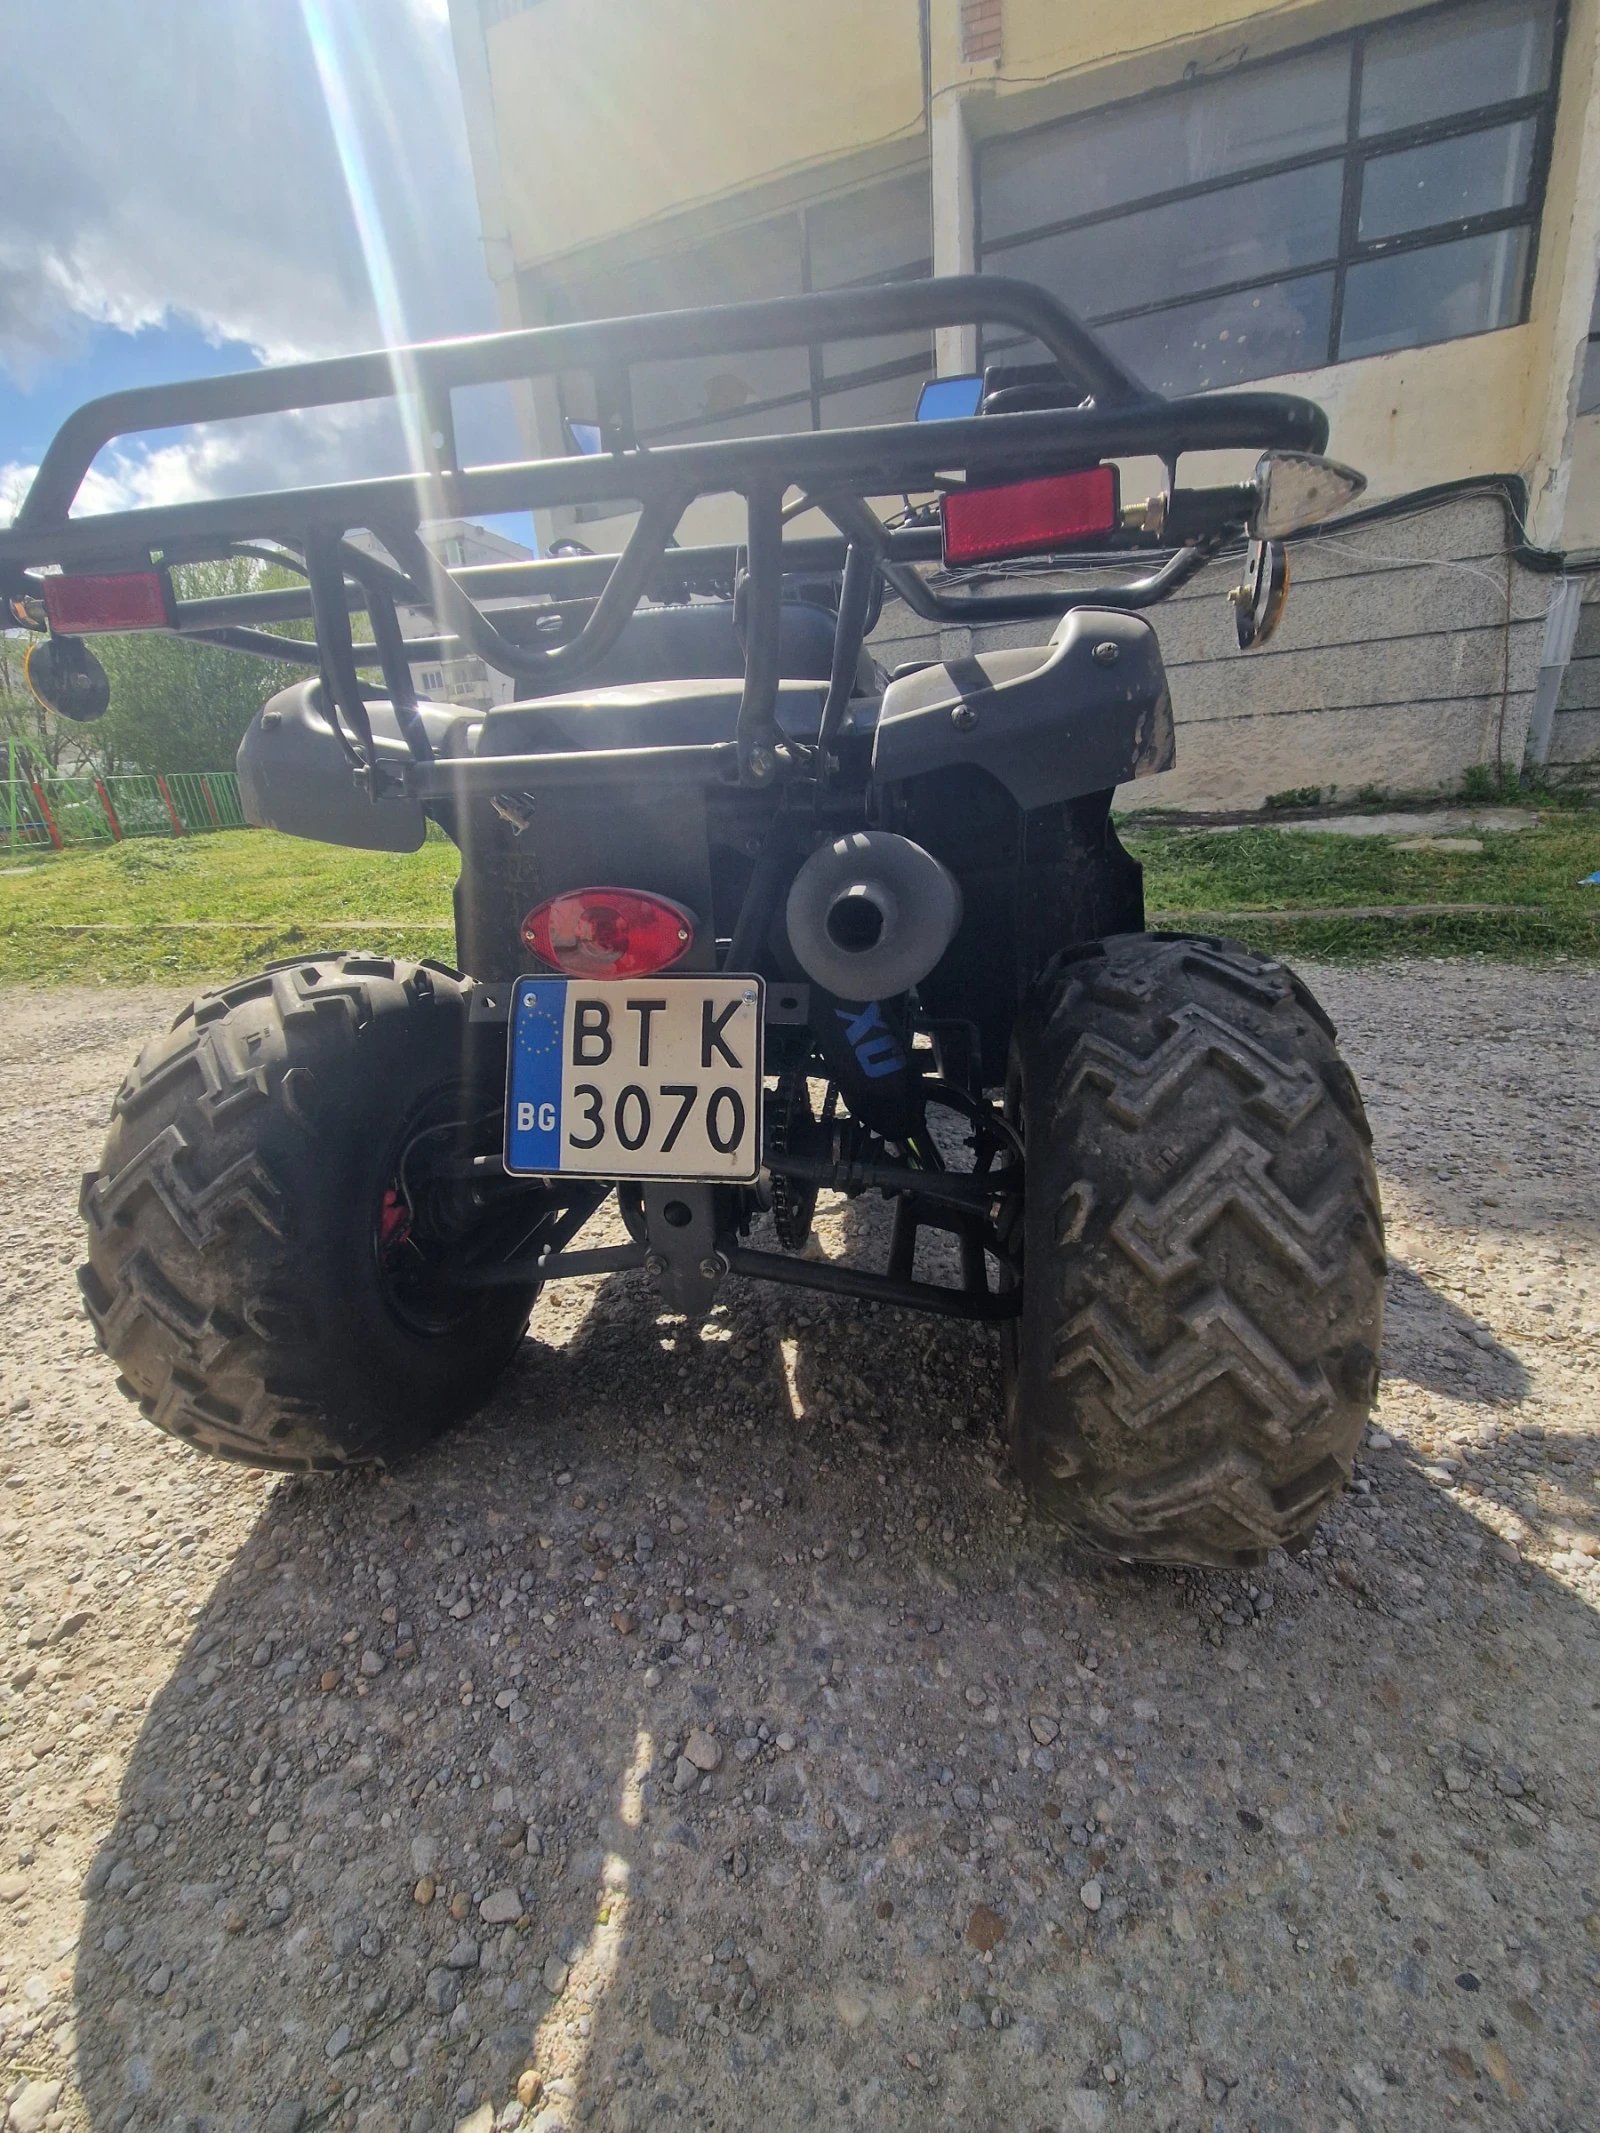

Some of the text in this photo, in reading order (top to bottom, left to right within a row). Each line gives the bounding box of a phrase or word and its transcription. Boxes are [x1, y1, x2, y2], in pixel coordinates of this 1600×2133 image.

[700, 1000, 744, 1069] K
[516, 1102, 556, 1132] BG
[569, 1084, 746, 1154] 3070
